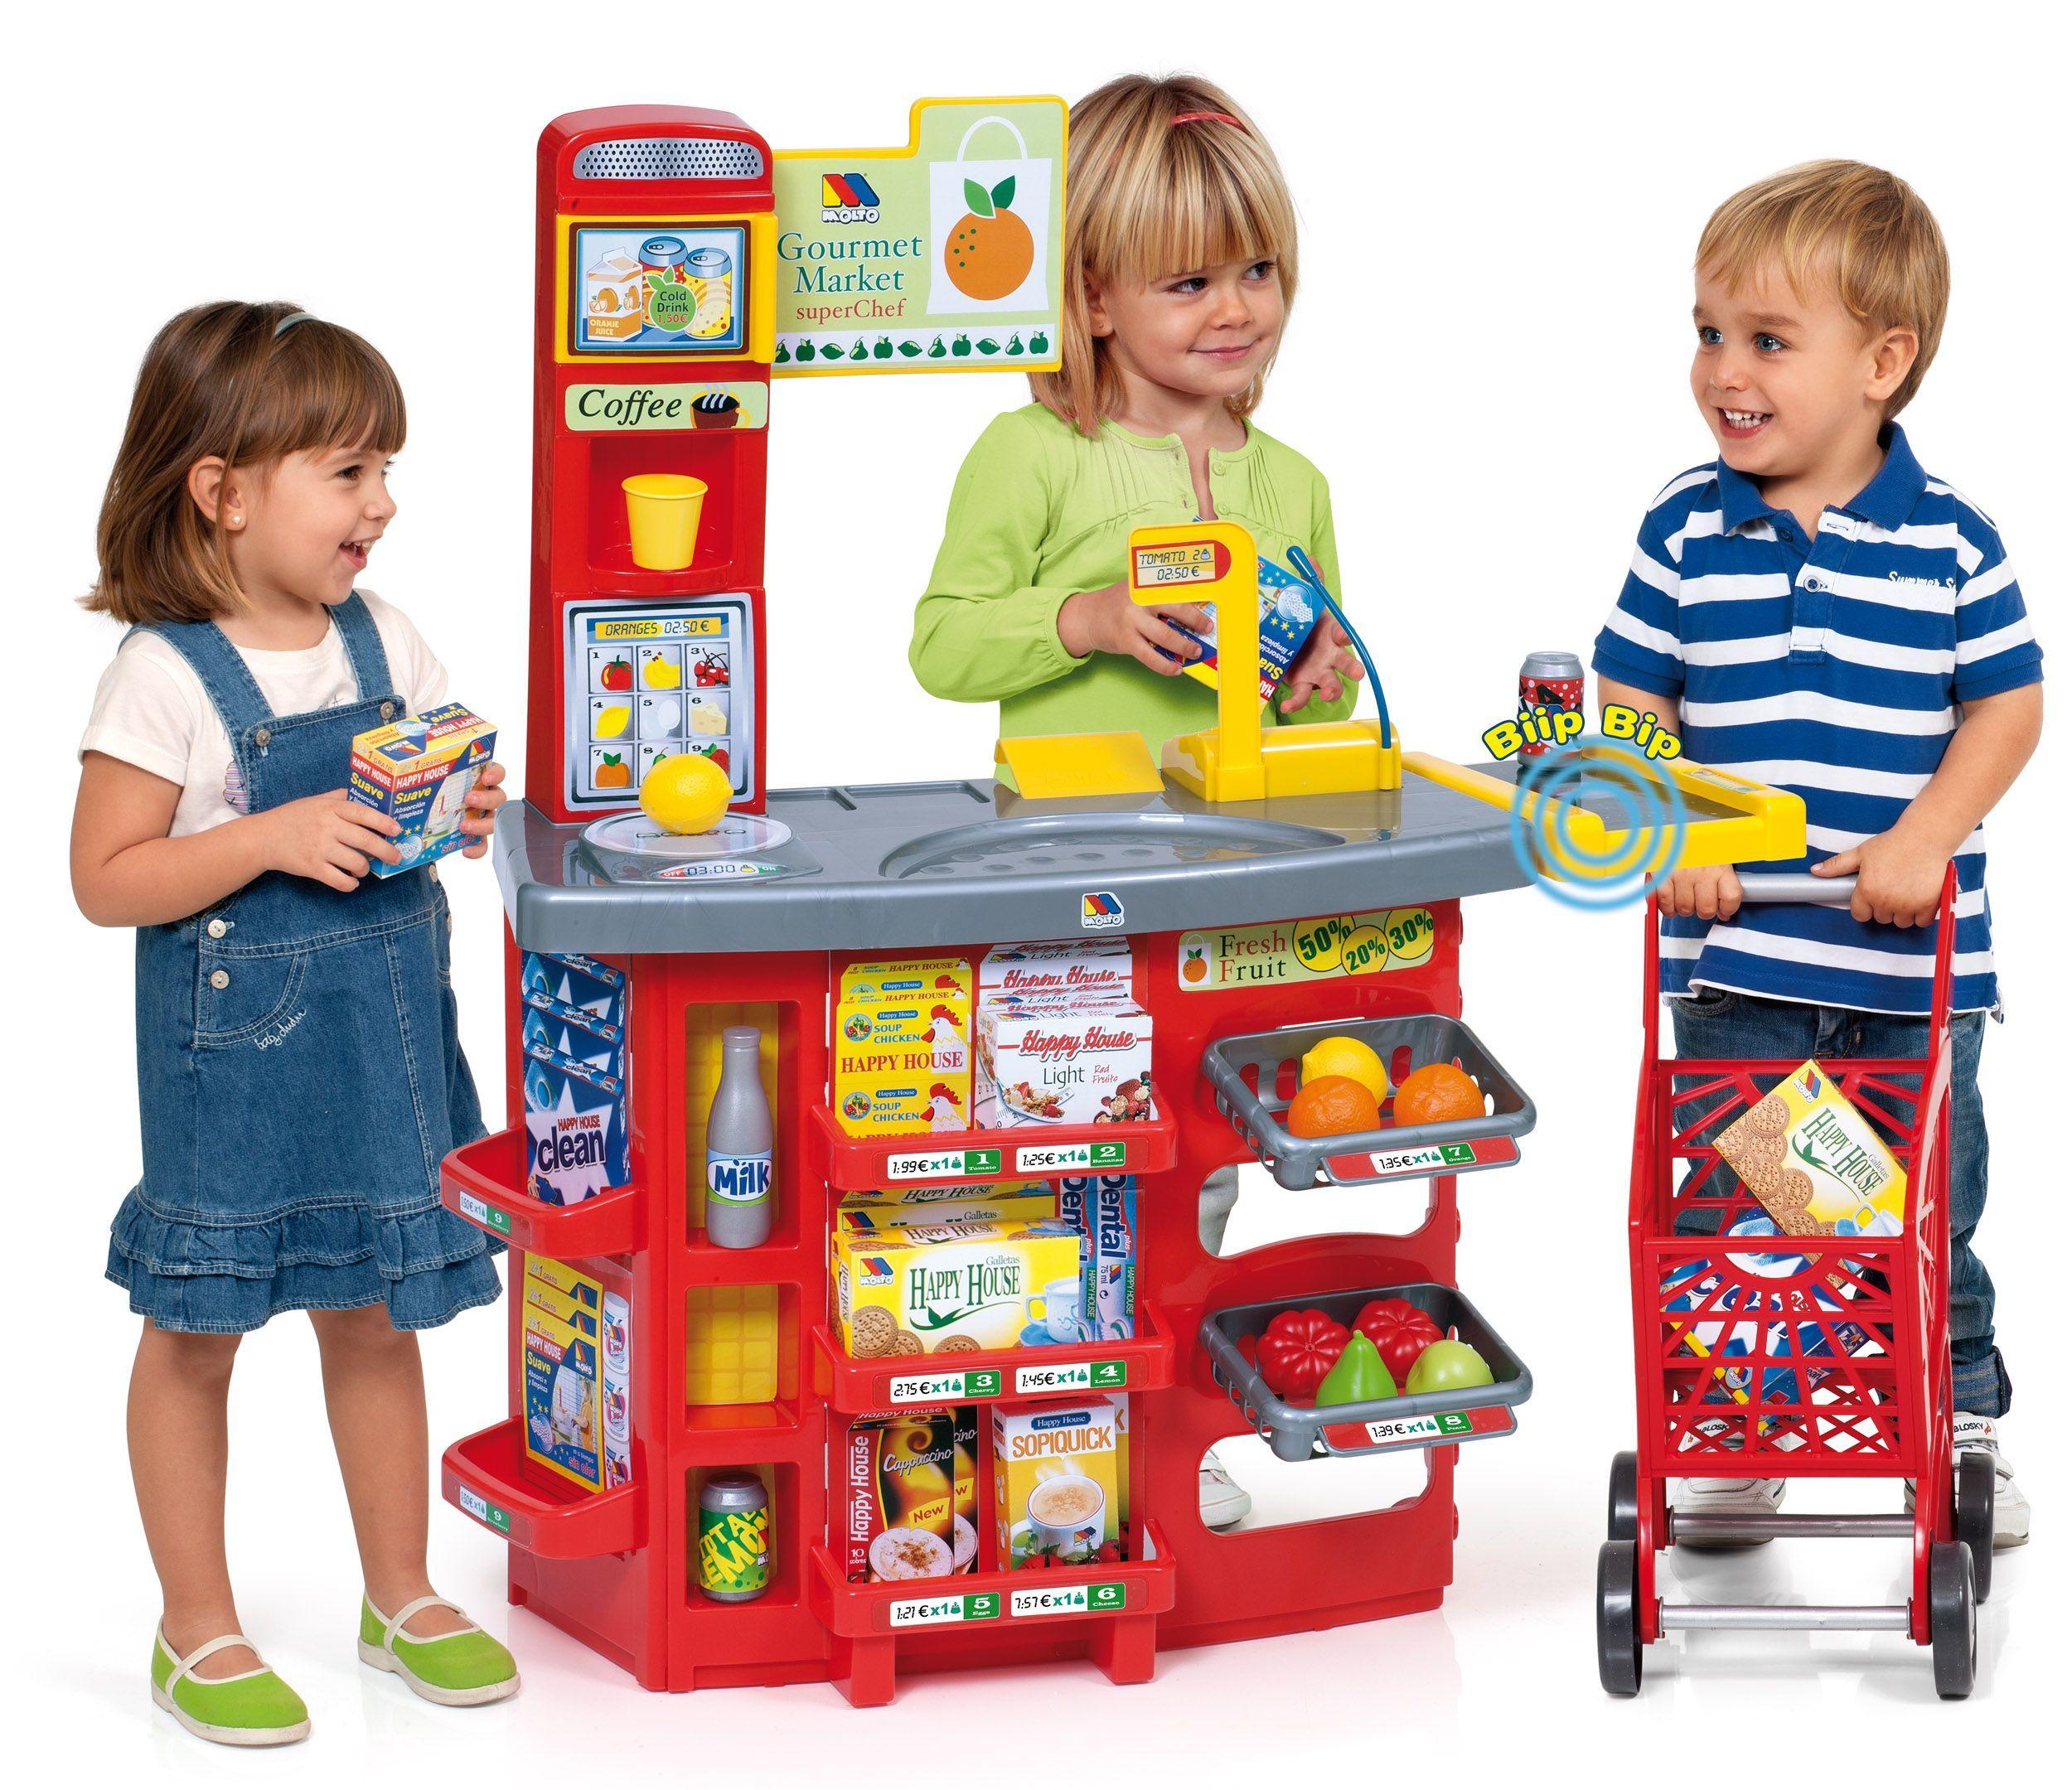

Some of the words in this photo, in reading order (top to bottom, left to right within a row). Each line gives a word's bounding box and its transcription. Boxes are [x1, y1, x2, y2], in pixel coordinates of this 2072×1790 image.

[821, 206, 881, 225] MOLTO
[777, 230, 923, 262] Gourmet
[792, 263, 906, 294] Market
[659, 291, 687, 302] Cold
[656, 302, 690, 313] Drink
[796, 298, 908, 322] superChef
[589, 319, 619, 328] ORANJE
[657, 314, 688, 324] 1,50€
[595, 327, 614, 336] JUICE
[579, 387, 683, 425] Coffee
[1139, 550, 1186, 565] TOMATO
[1193, 549, 1200, 560] 2
[1157, 567, 1188, 580] 02:50
[1191, 565, 1200, 577] €
[605, 622, 658, 636] ORANGES
[664, 621, 698, 634] 02:50
[700, 620, 709, 632] €
[430, 708, 468, 723] Suave
[352, 756, 370, 775] HAPPY
[371, 766, 392, 787] HOUSE
[396, 773, 423, 789] HAPPY
[424, 764, 450, 781] HOUSE
[351, 772, 384, 800] Suave
[350, 787, 379, 808] Absorción
[394, 786, 432, 805] Suave
[394, 801, 426, 815] Absorción
[664, 868, 682, 877] OFF
[687, 865, 736, 876] 03:00
[1084, 915, 1122, 927] MOLTO
[1391, 908, 1434, 951] 30%
[1218, 931, 1287, 958] Fresh
[1296, 915, 1352, 961] 50%
[1030, 951, 1071, 960] Light
[1344, 935, 1386, 971] 20%
[566, 957, 593, 968] clean
[888, 964, 920, 973] HAPPY
[922, 962, 954, 970] HOUSE
[1218, 955, 1287, 983] Fruit
[1028, 995, 1068, 1004] Light
[565, 1013, 592, 1023] clean
[879, 1011, 900, 1019] Happy
[874, 1023, 903, 1033] SOUP
[874, 1033, 920, 1044] CHICKEN
[1020, 1028, 1082, 1060] Happy
[1082, 1026, 1135, 1050] House
[840, 1054, 900, 1074] HAPPY
[903, 1051, 963, 1070] HOUSE
[565, 1064, 592, 1075] clean
[1093, 1064, 1111, 1075] Red
[1043, 1065, 1086, 1089] Light
[873, 1102, 902, 1111] SOUP
[558, 1115, 579, 1132] HAPPY
[579, 1114, 601, 1130] HOUSE
[873, 1112, 920, 1123] CHICKEN
[538, 1127, 606, 1172] clean
[1100, 1145, 1117, 1158] 2
[1448, 1147, 1460, 1157] 7
[1801, 1107, 1852, 1157] HAPPY
[1832, 1144, 1884, 1196] HOUSE
[975, 1153, 990, 1166] 1
[1057, 1150, 1076, 1163] x1
[1413, 1152, 1430, 1164] x1
[930, 1157, 949, 1170] x1
[1868, 1153, 1890, 1179] Galletas
[714, 1159, 770, 1197] Milk
[903, 1189, 947, 1200] HAPPY
[947, 1187, 993, 1197] HOUSE
[494, 1212, 502, 1224] 9
[964, 1210, 997, 1221] Galletas
[1101, 1174, 1127, 1260] Dental
[904, 1227, 949, 1240] HAPPY
[949, 1225, 997, 1236] HOUSE
[985, 1255, 1020, 1265] Galletas
[543, 1272, 558, 1284] GRATIS
[859, 1275, 894, 1286] MOLTO
[1087, 1270, 1096, 1295] HAPPY
[1126, 1266, 1135, 1290] HAPPY
[909, 1267, 963, 1310] HAPPY
[966, 1263, 1021, 1306] HOUSE
[541, 1300, 557, 1313] GRATIS
[1086, 1296, 1095, 1318] HOUSE
[1126, 1290, 1135, 1314] HOUSE
[540, 1328, 555, 1340] GRATIS
[526, 1331, 544, 1352] HAPPY
[544, 1339, 561, 1362] HOUSE
[527, 1351, 551, 1376] Suave
[1056, 1370, 1076, 1383] x1
[1099, 1365, 1118, 1377] 4
[931, 1380, 950, 1393] x1
[975, 1374, 993, 1387] 3
[1094, 1376, 1121, 1384] Lemon
[531, 1381, 548, 1394] limpieza
[968, 1386, 996, 1396] Cherry
[859, 1410, 901, 1419] Happy
[1445, 1415, 1462, 1425] 8
[1037, 1418, 1061, 1428] Happy
[1063, 1415, 1086, 1425] House
[1408, 1421, 1424, 1433] x1
[1012, 1425, 1112, 1459] SOPIQUICK
[569, 1456, 580, 1471] sin
[850, 1435, 869, 1487] House
[883, 1448, 954, 1478] Cappuccino
[493, 1510, 502, 1522] 9
[850, 1488, 872, 1541] Happy
[913, 1504, 944, 1523] New
[850, 1549, 864, 1557] 10
[1053, 1592, 1072, 1606] x1
[1097, 1586, 1116, 1600] 6
[930, 1602, 948, 1616] x1
[974, 1596, 990, 1609] 5
